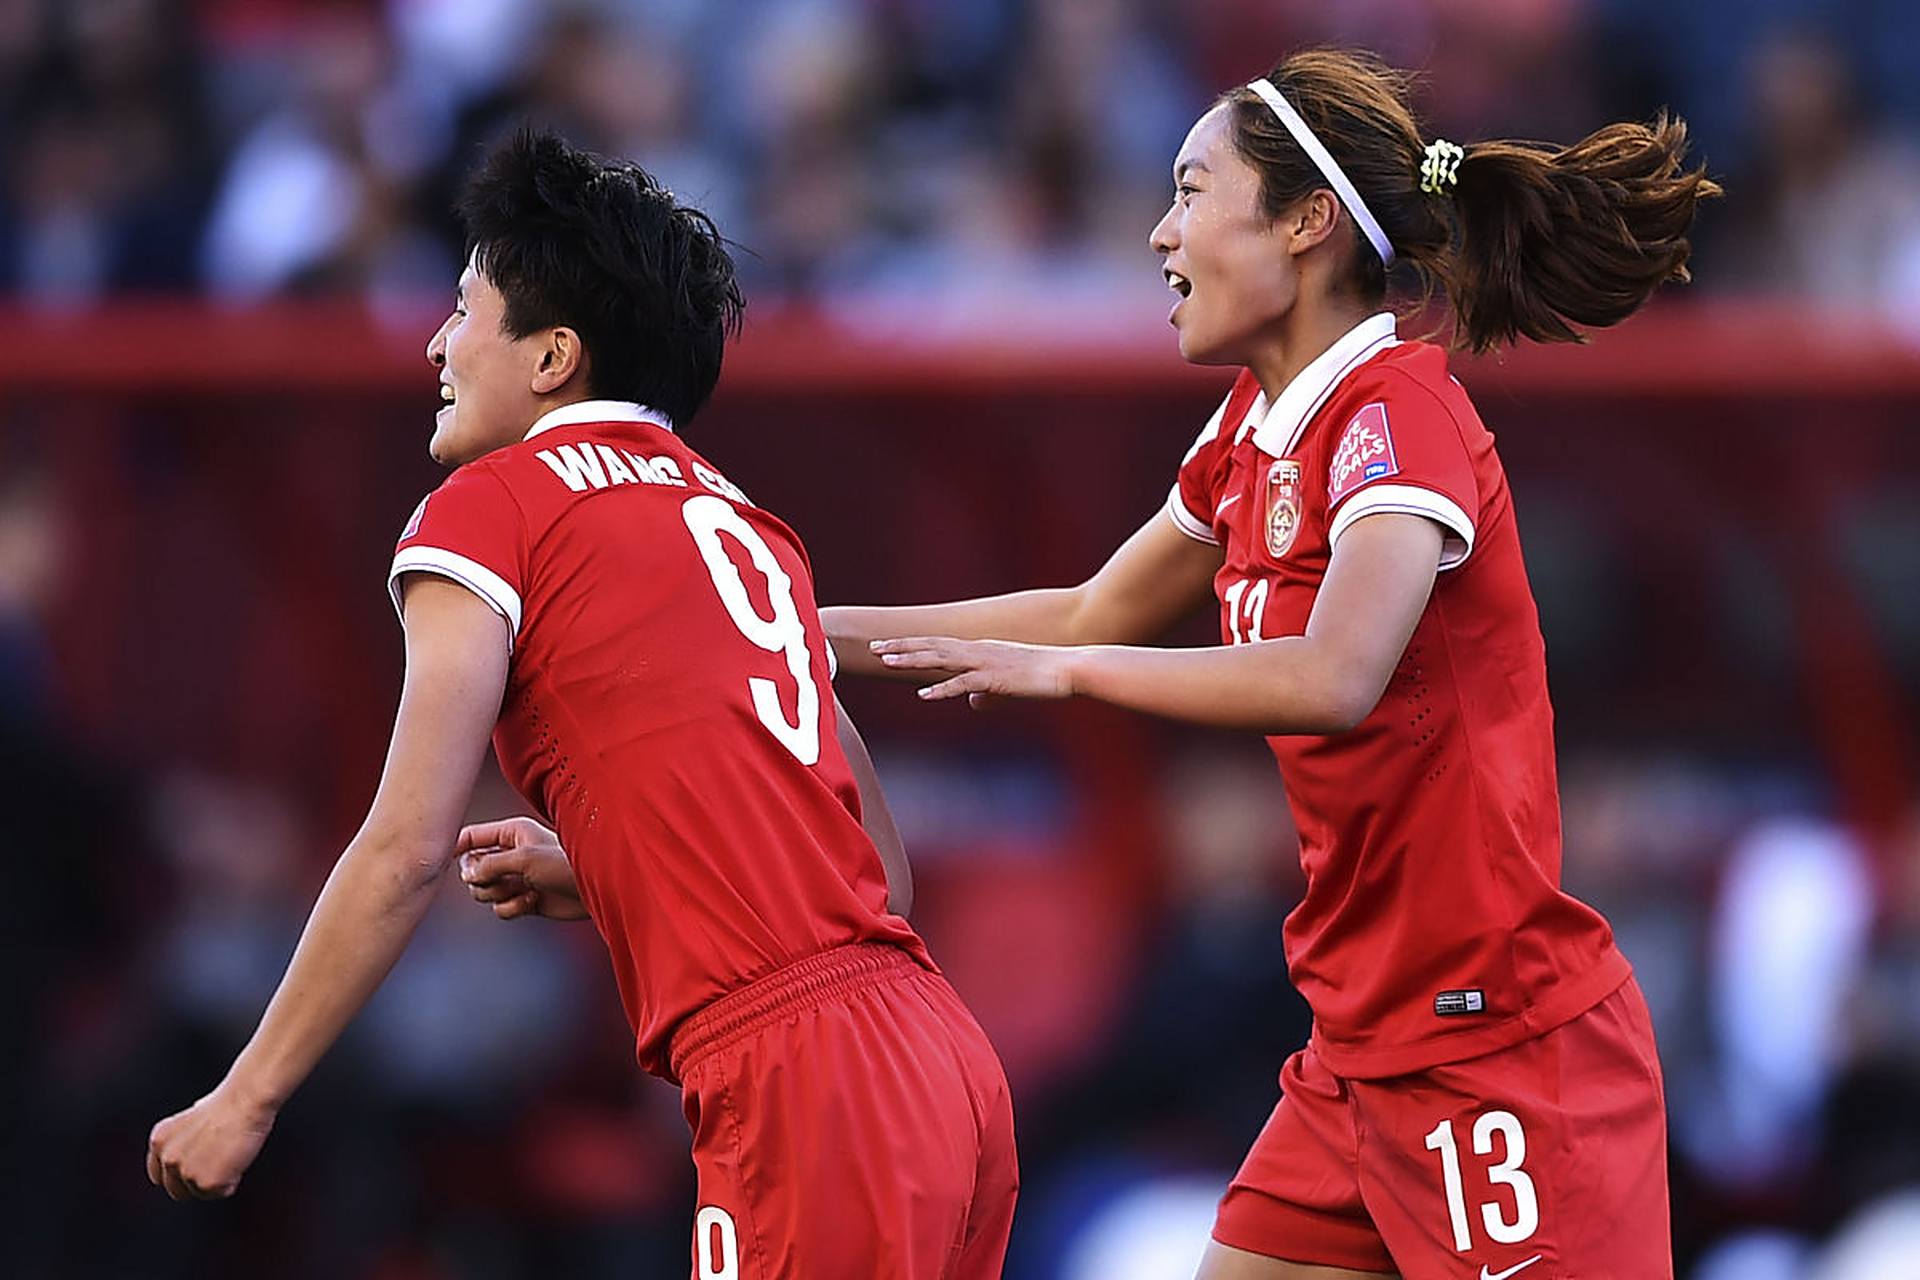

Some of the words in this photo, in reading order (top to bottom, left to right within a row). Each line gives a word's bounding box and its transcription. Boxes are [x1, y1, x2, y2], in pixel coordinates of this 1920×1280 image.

[535, 442, 688, 492] WANG
[682, 495, 819, 766] 9
[1425, 1110, 1539, 1252] 13
